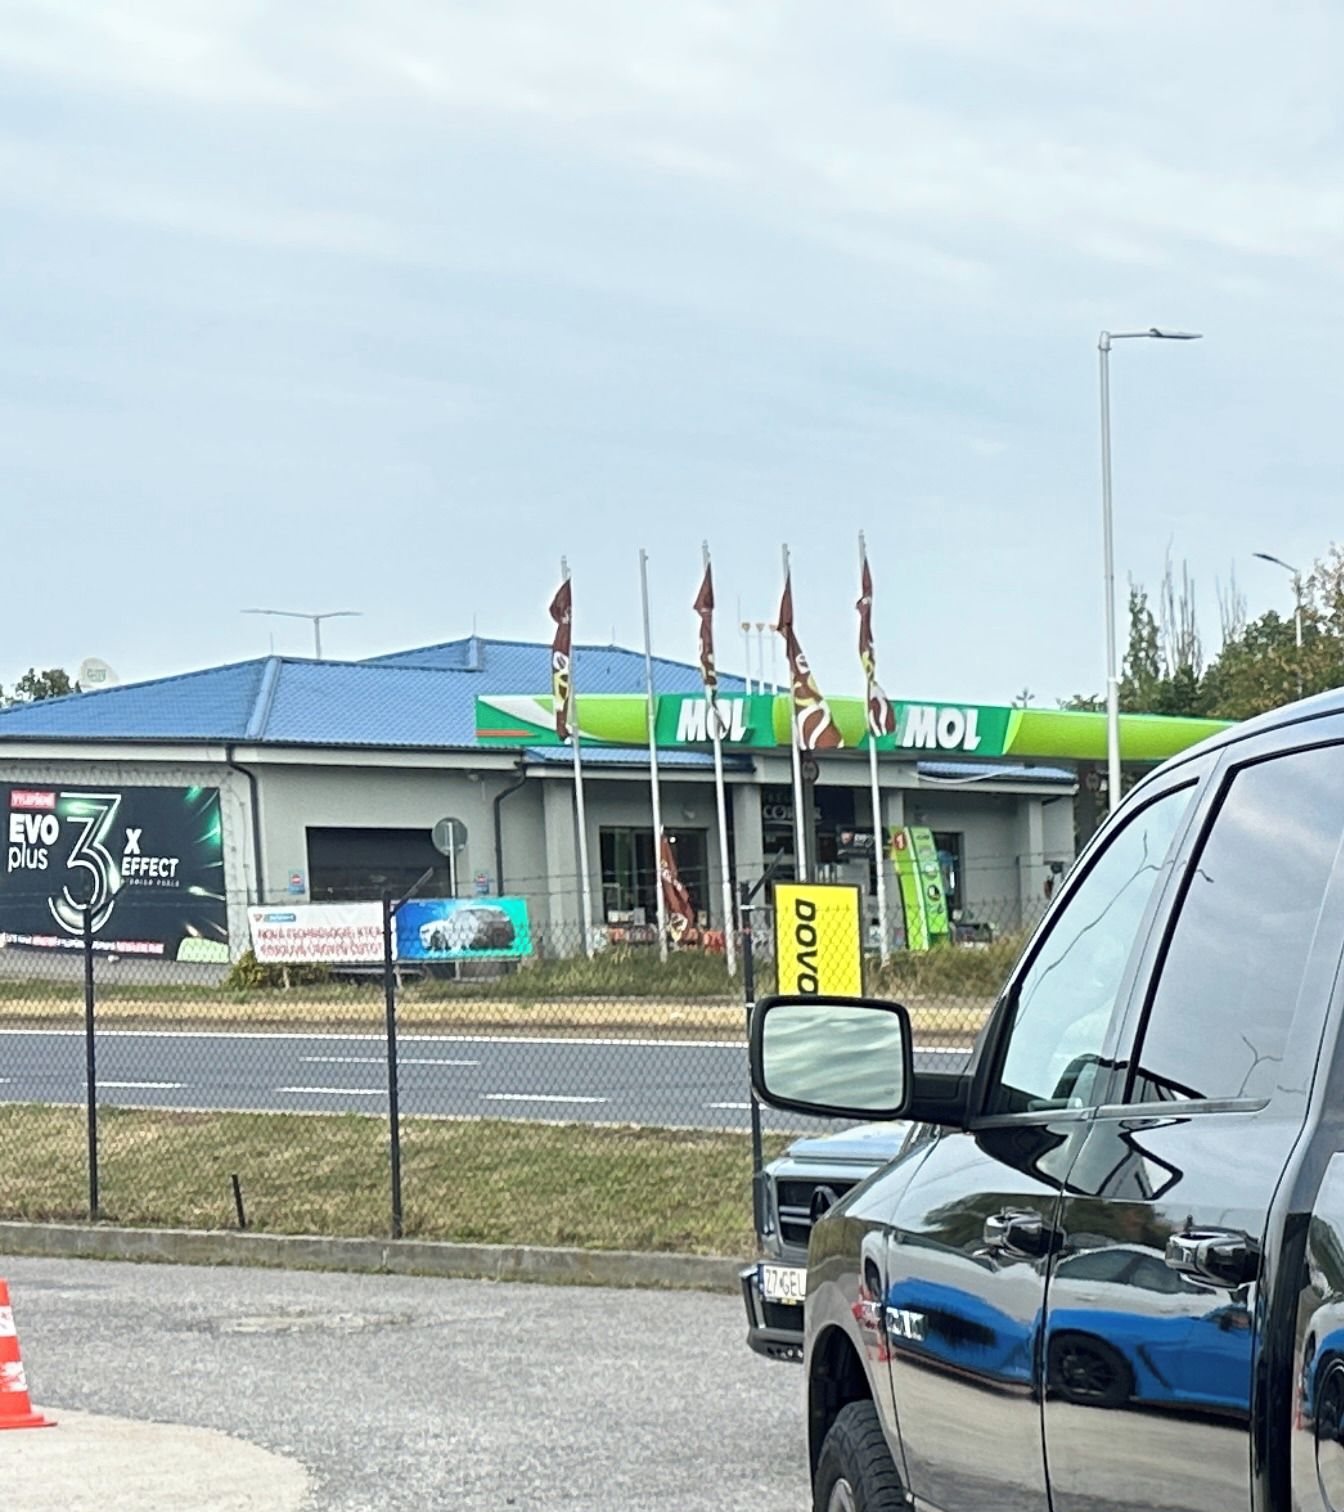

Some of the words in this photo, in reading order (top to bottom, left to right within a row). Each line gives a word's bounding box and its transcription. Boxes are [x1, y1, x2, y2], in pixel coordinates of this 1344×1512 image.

[676, 697, 747, 742] MOL
[902, 704, 982, 751] MOL
[9, 812, 59, 846] EVO
[8, 841, 48, 873] plus
[121, 857, 179, 877] EFFECT
